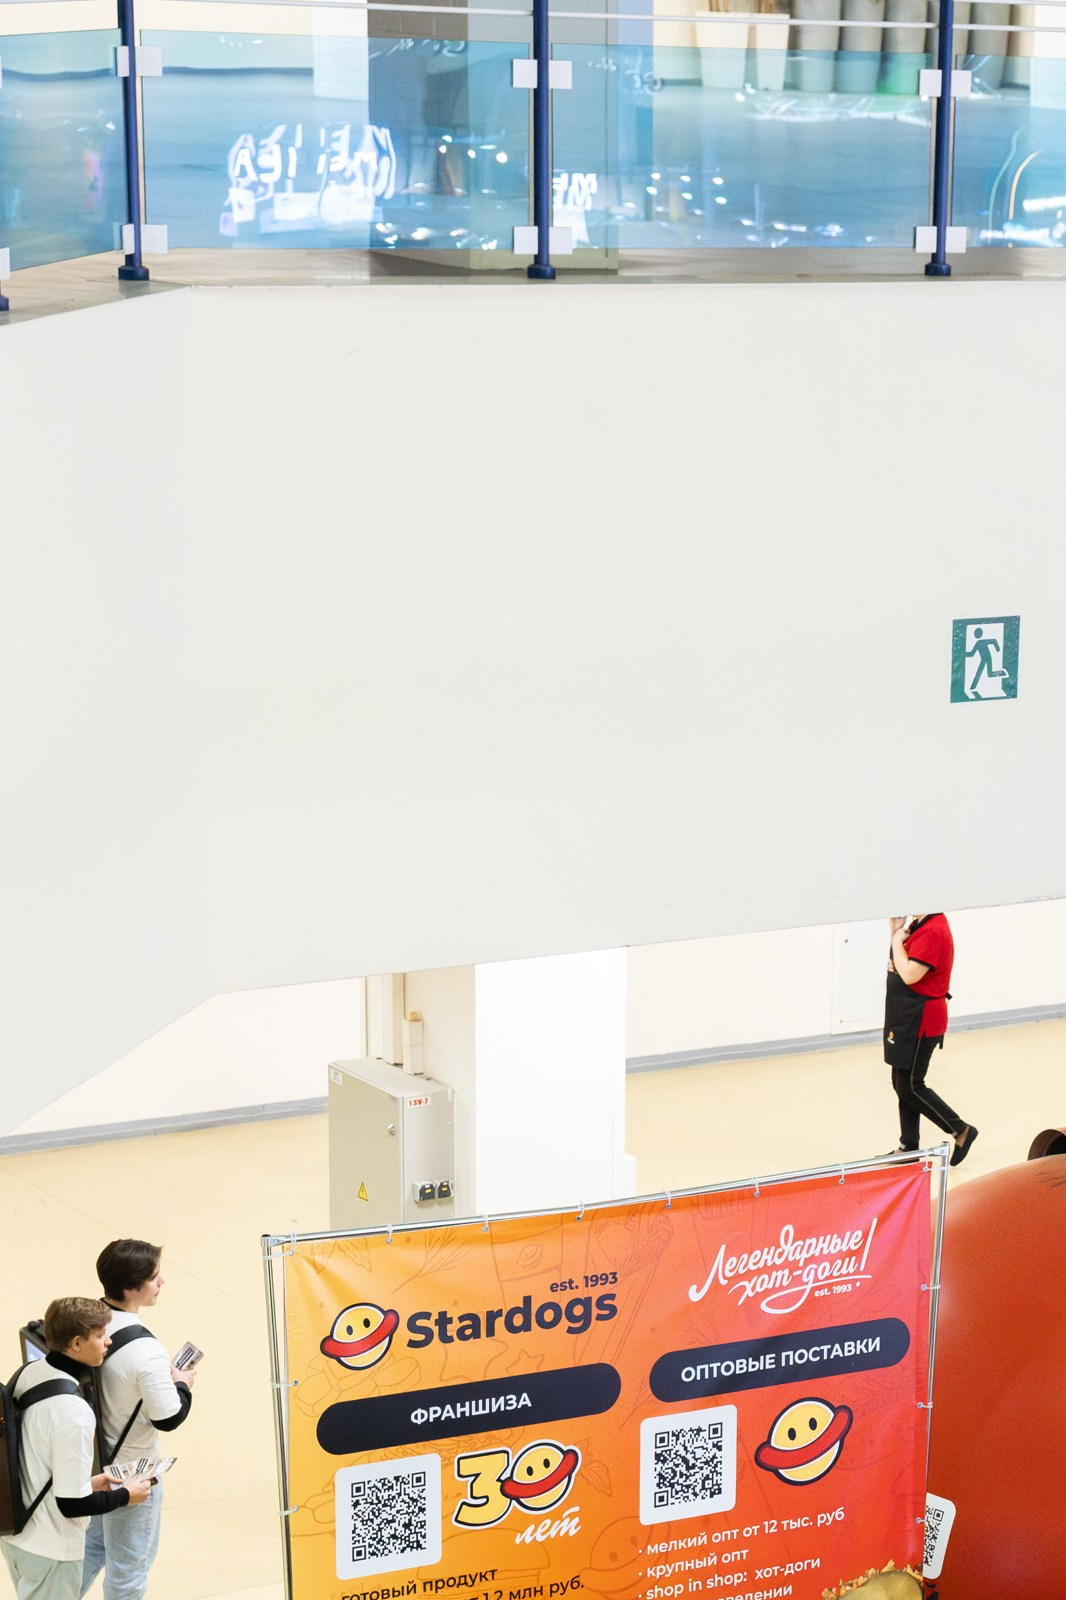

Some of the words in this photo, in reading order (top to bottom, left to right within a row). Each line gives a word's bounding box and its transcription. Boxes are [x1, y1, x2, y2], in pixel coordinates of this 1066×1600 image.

[688, 1224, 864, 1302] Легендарные
[550, 1278, 579, 1293] est.
[583, 1271, 618, 1288] 1993
[814, 1286, 830, 1297] est.
[832, 1284, 852, 1294] 1993
[406, 1293, 618, 1349] Stardogs
[681, 1353, 776, 1382] ОПТОВЫЕ
[781, 1337, 881, 1366] ПОСТАВКИ
[410, 1392, 532, 1425] ФРАНШИЗА
[515, 1506, 581, 1544] лет
[647, 1531, 708, 1555] мелкий
[711, 1528, 740, 1543] опт
[743, 1525, 760, 1538] от
[762, 1519, 778, 1534] 12
[781, 1515, 813, 1531] тыс.
[817, 1506, 845, 1528] руб
[423, 1567, 498, 1595] продукт
[646, 1552, 717, 1581] крупный
[721, 1548, 749, 1564] опт
[646, 1581, 684, 1600] shop
[688, 1577, 703, 1593] in
[706, 1570, 748, 1590] shop:
[755, 1557, 821, 1580] хот-доги
[549, 1575, 585, 1598] руб.
